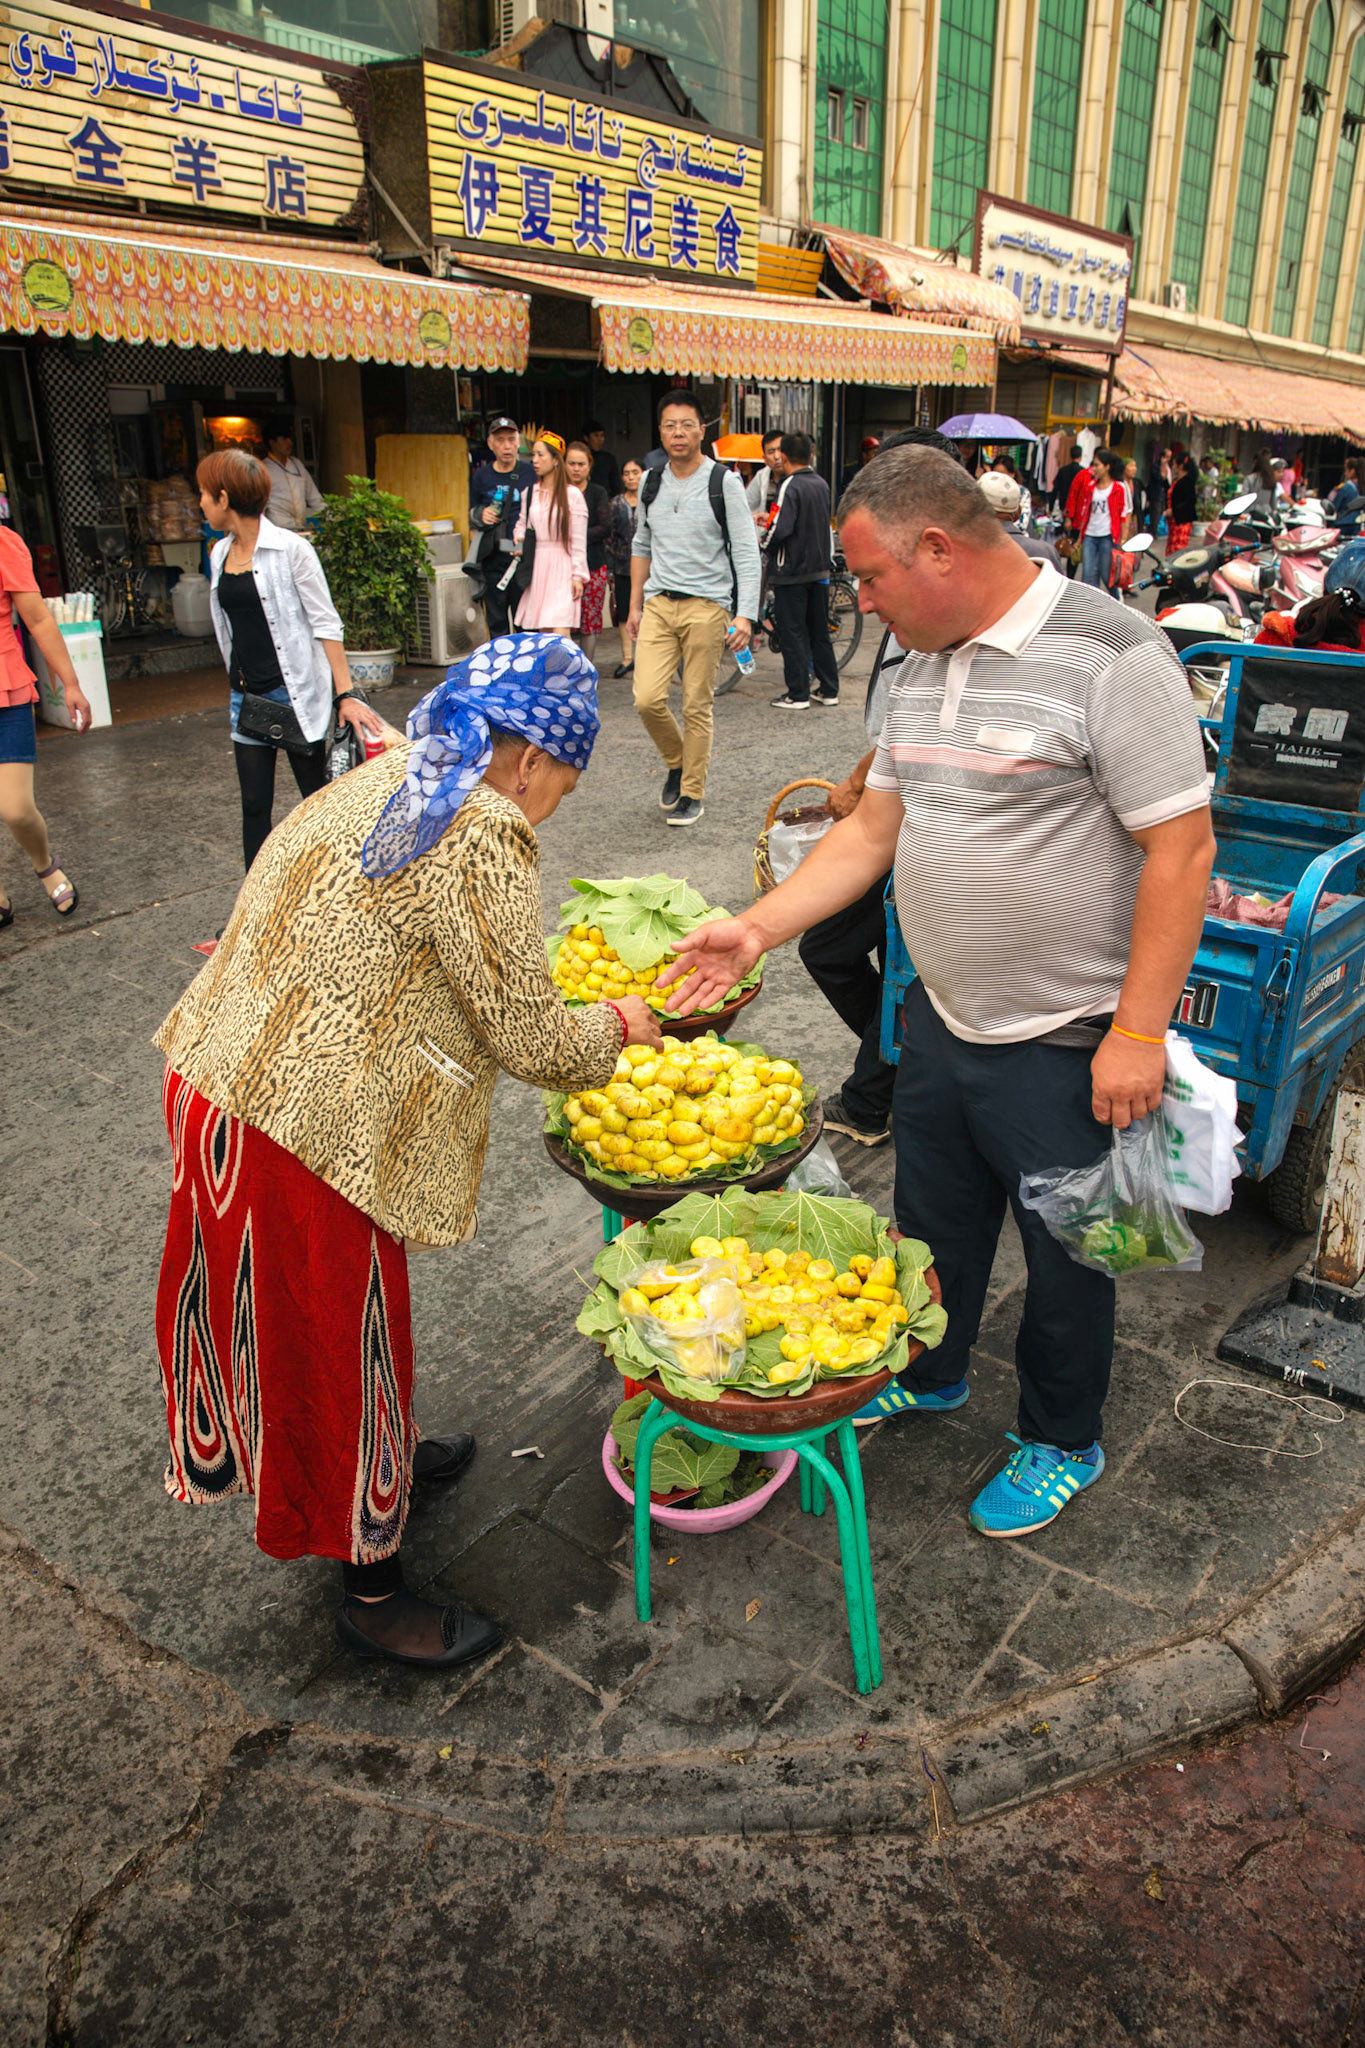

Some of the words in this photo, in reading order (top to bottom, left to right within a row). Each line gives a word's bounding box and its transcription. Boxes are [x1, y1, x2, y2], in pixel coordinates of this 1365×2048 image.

[10, 28, 78, 88] قوي
[0, 107, 307, 217] 全羊店
[458, 152, 742, 275] 伊夏其尼美食
